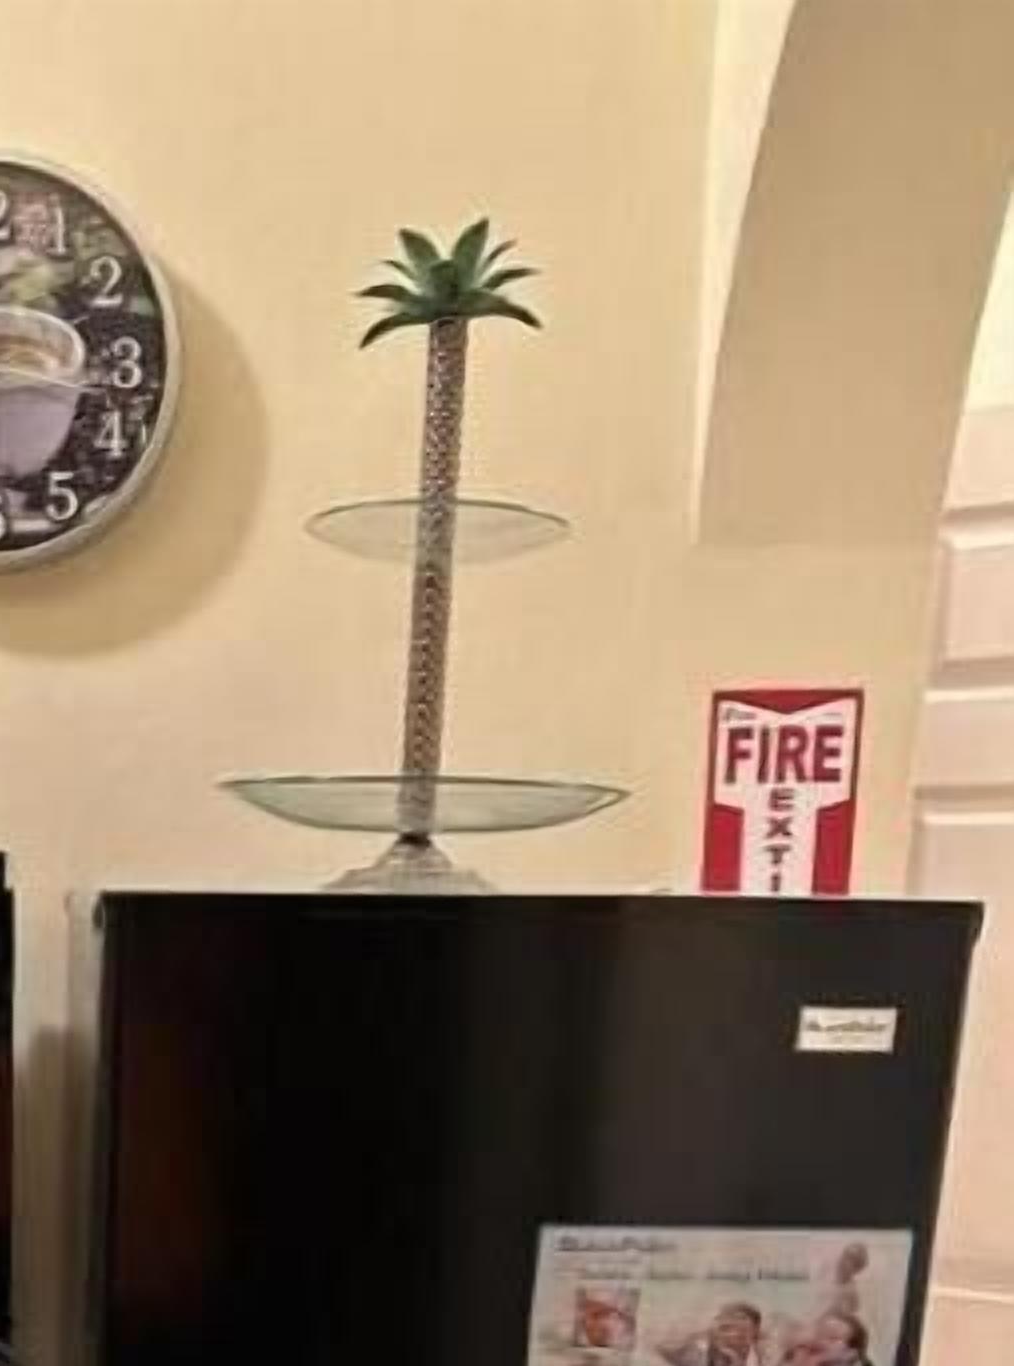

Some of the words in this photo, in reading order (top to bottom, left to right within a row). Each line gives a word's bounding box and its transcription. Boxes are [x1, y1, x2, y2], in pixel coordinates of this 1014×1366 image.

[51, 193, 69, 255] 1
[90, 256, 123, 306] 2
[112, 337, 143, 388] 3
[94, 410, 128, 457] 4
[46, 472, 78, 520] 5
[724, 725, 844, 784] FIRE
